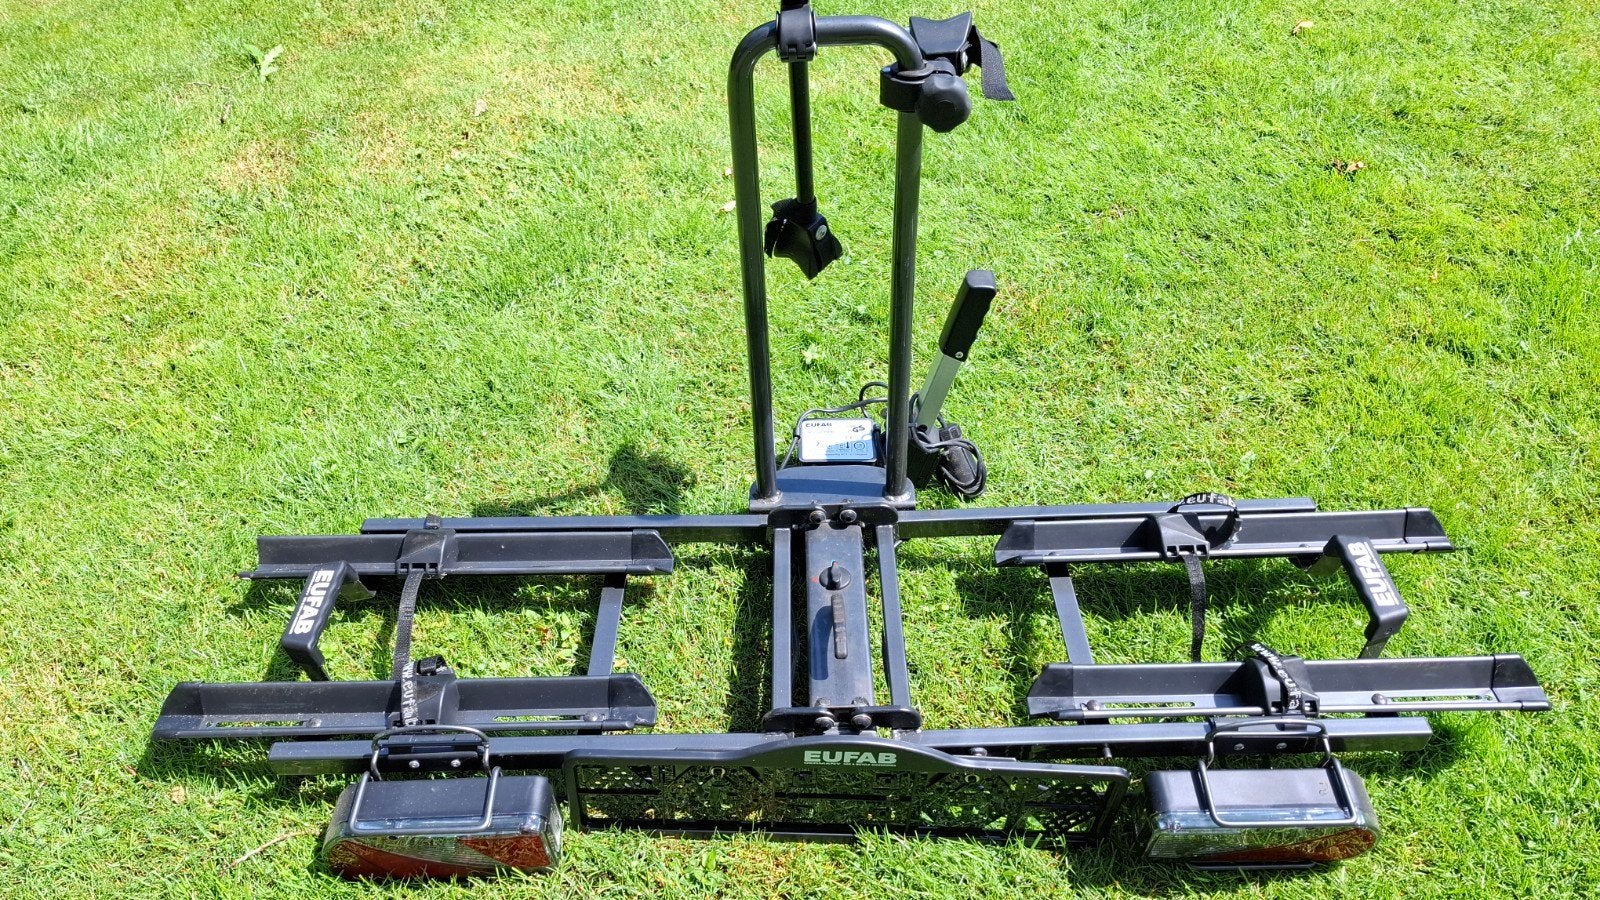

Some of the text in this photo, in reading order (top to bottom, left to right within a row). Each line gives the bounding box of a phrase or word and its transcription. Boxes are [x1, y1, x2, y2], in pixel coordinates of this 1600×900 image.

[294, 570, 335, 635] EUFAB
[1347, 541, 1396, 606] EUFAB
[803, 750, 897, 765] EUFAB
